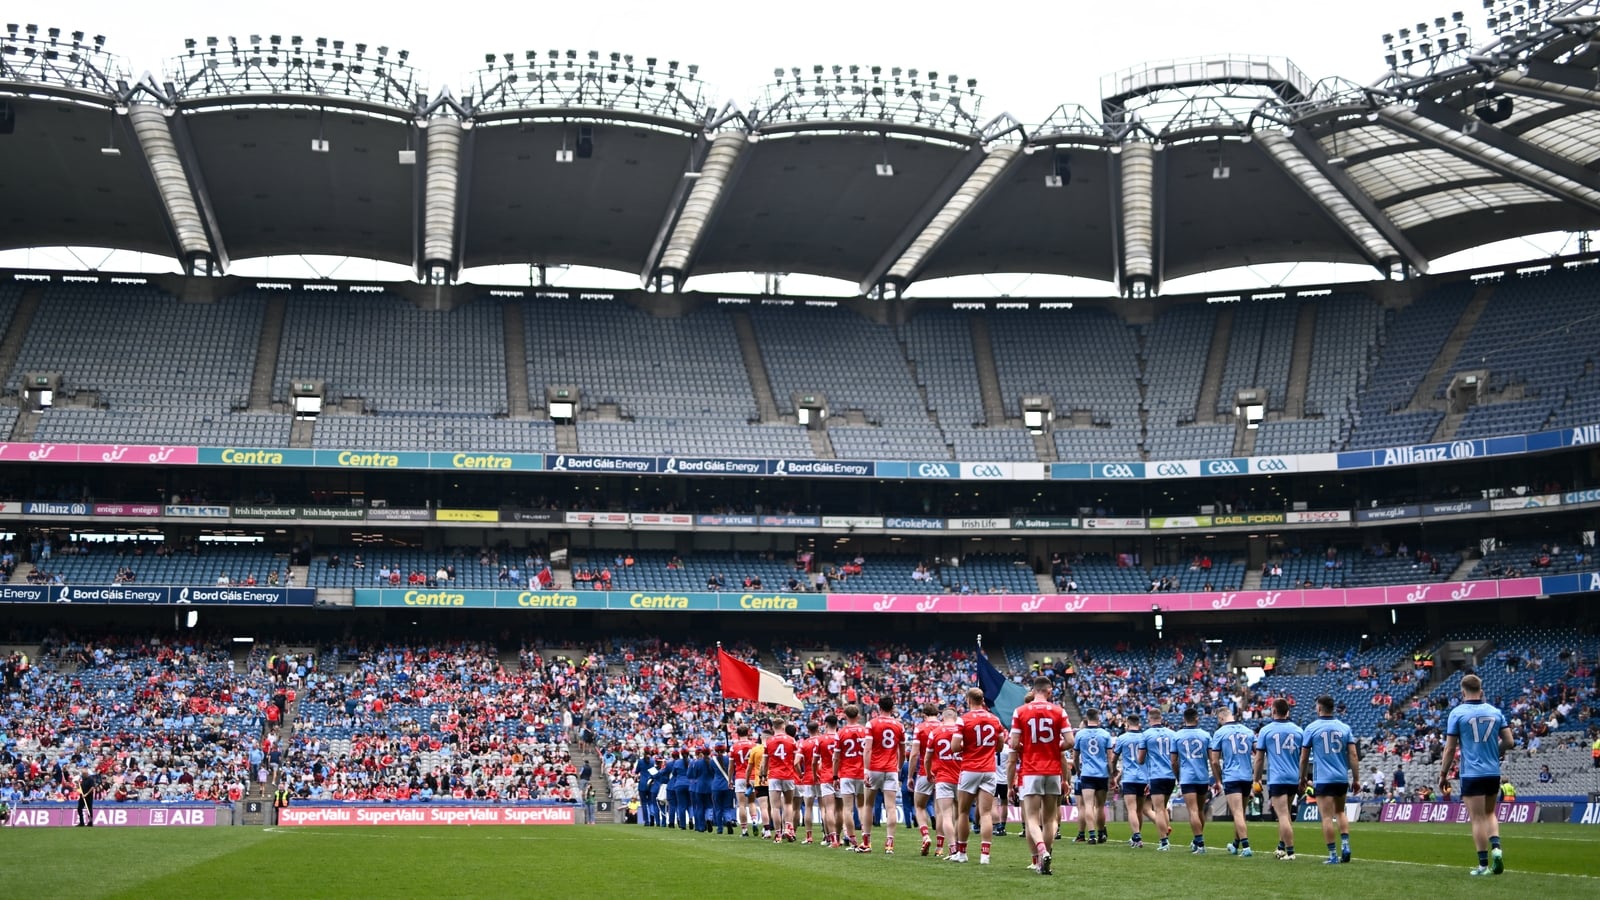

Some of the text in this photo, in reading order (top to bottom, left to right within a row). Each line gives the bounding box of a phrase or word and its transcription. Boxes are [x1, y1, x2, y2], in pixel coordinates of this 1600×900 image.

[29, 444, 54, 460] eir
[102, 445, 128, 462] eir
[149, 446, 174, 462] eir
[222, 449, 283, 464] Centra
[338, 451, 398, 466] Centra
[1384, 447, 1447, 465] Allianz
[453, 453, 512, 468] Centra
[568, 458, 649, 470] Bord Gáis Energy
[679, 460, 759, 472] Bord Gáis Energy
[789, 462, 867, 474] Bord Gáis Energy
[1208, 461, 1239, 474] GAA
[1257, 459, 1287, 471] GAA
[919, 464, 950, 476] GAA
[972, 465, 1003, 477] GAA
[1102, 464, 1134, 477] GAA
[1157, 463, 1188, 476] GAA
[30, 503, 69, 514] Allianz
[97, 506, 123, 514] entegro
[132, 507, 158, 515] entegro
[251, 508, 289, 516] Independent
[303, 508, 357, 518] Irish Independent
[1434, 503, 1472, 513] www.cgl.ie
[887, 518, 941, 528] @CrokePark
[962, 520, 996, 528] Irish Life
[1215, 515, 1282, 524] GAEL FORM
[4, 590, 41, 599] Energy
[74, 590, 161, 601] Bord Gáis Energy
[193, 591, 279, 602] Bord Gáis Energy
[404, 591, 464, 605] Centra
[1407, 585, 1430, 602] eir
[1452, 582, 1476, 600] eir
[518, 592, 577, 606] Centra
[630, 594, 688, 608] Centra
[740, 595, 798, 609] Centra
[873, 594, 897, 611] eir
[916, 595, 940, 612] eir
[1021, 595, 1045, 611] eir
[1065, 595, 1089, 611] eir
[1212, 593, 1236, 610] eir
[1257, 591, 1281, 608] eir
[974, 724, 995, 746] 12
[1028, 718, 1054, 743] 15
[1468, 716, 1496, 742] 17
[882, 729, 895, 748] 8
[1157, 737, 1170, 755] 11
[1229, 734, 1248, 754] 13
[1272, 733, 1296, 755] 14
[1321, 731, 1342, 754] 15
[774, 744, 787, 760] 4
[1088, 738, 1099, 755] 8
[1183, 740, 1203, 759] 12
[16, 810, 49, 825] AIB
[93, 810, 128, 825] AIB
[171, 810, 204, 824] AIB
[282, 808, 571, 824] SuperValu SuperValu SuperValu SuperValu
[1394, 804, 1412, 820] AIB
[1429, 804, 1449, 821] AIB
[1508, 804, 1529, 822] AIB
